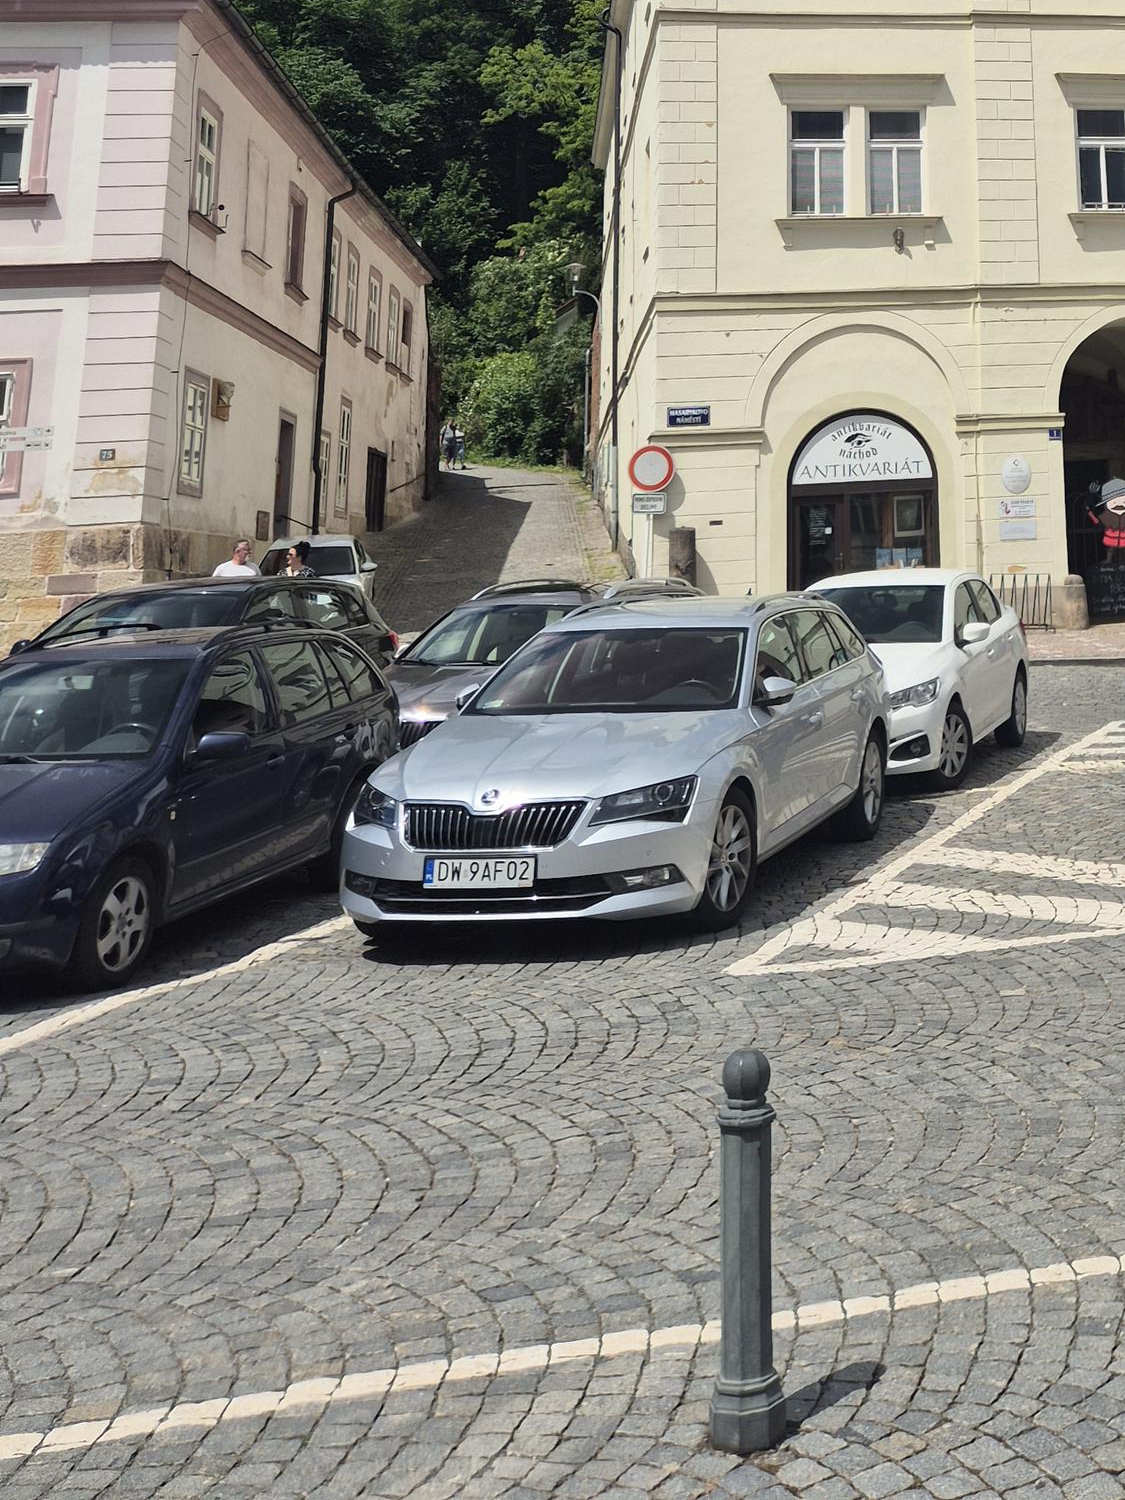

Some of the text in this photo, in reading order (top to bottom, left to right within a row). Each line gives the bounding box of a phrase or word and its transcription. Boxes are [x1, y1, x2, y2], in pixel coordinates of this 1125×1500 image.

[831, 422, 892, 442] antikvariát
[102, 451, 113, 460] 75
[839, 447, 878, 460] náchod
[799, 457, 924, 479] ANTIKVARIÁT
[438, 860, 529, 881] DW 9AF02
